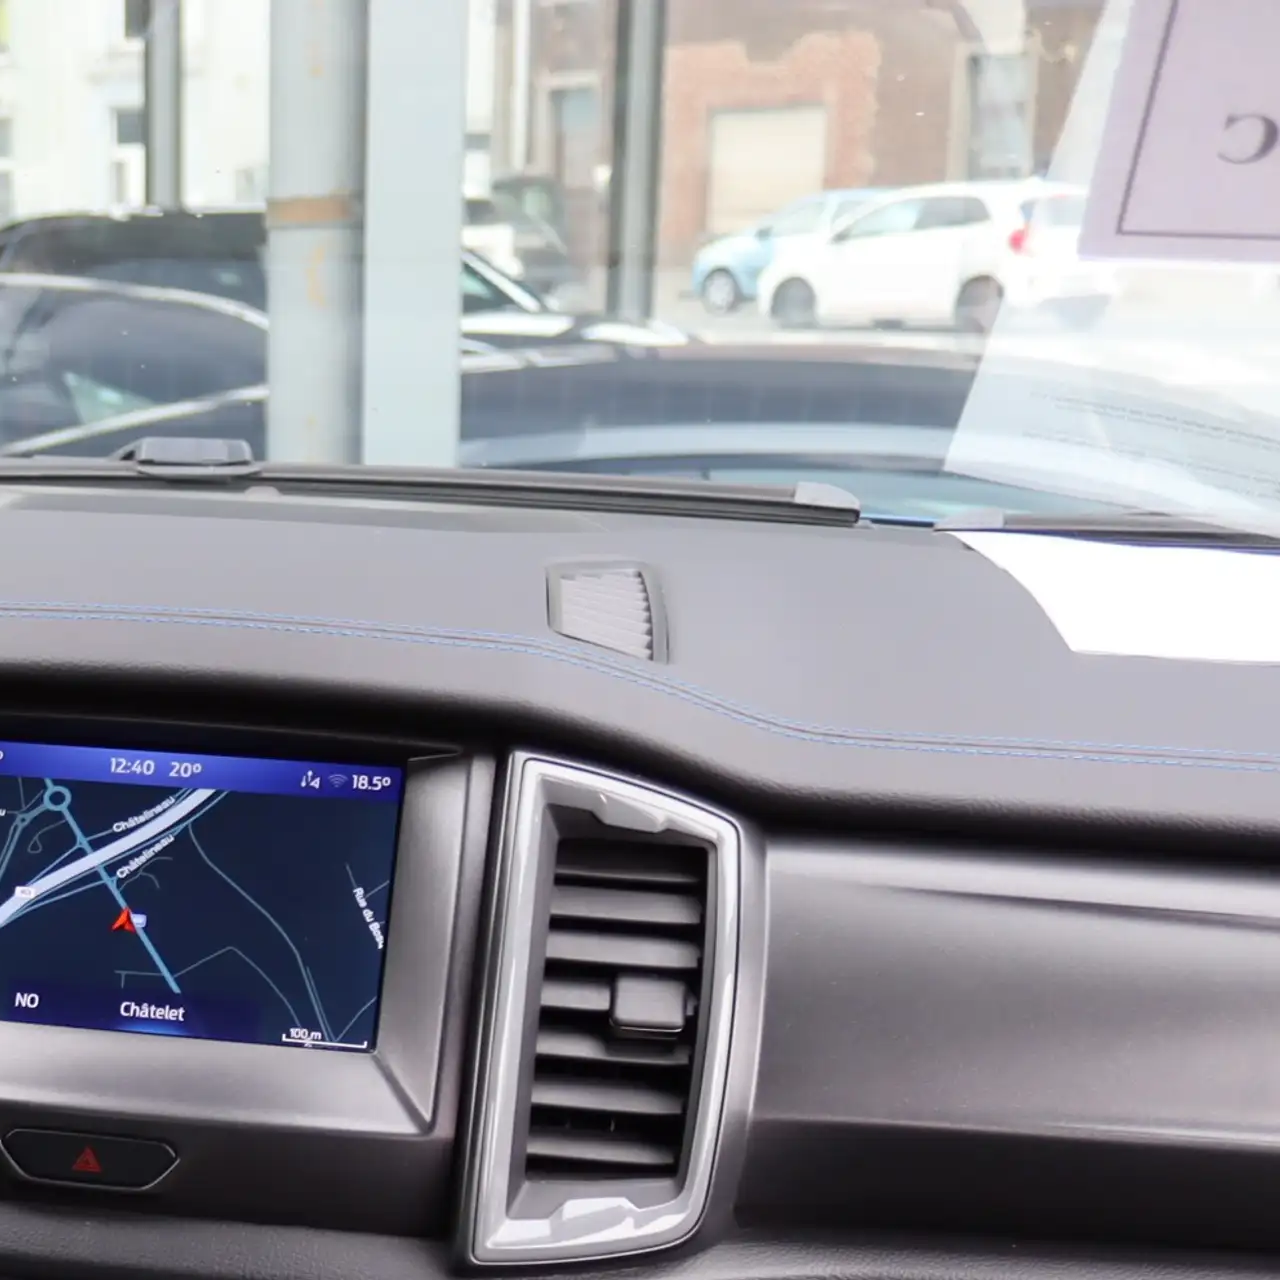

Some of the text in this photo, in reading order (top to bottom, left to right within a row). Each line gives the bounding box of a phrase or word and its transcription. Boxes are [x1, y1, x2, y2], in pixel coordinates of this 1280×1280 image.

[109, 756, 156, 776] 12:40
[362, 908, 375, 923] du
[14, 992, 40, 1008] NO
[119, 1001, 185, 1022] Châtelet
